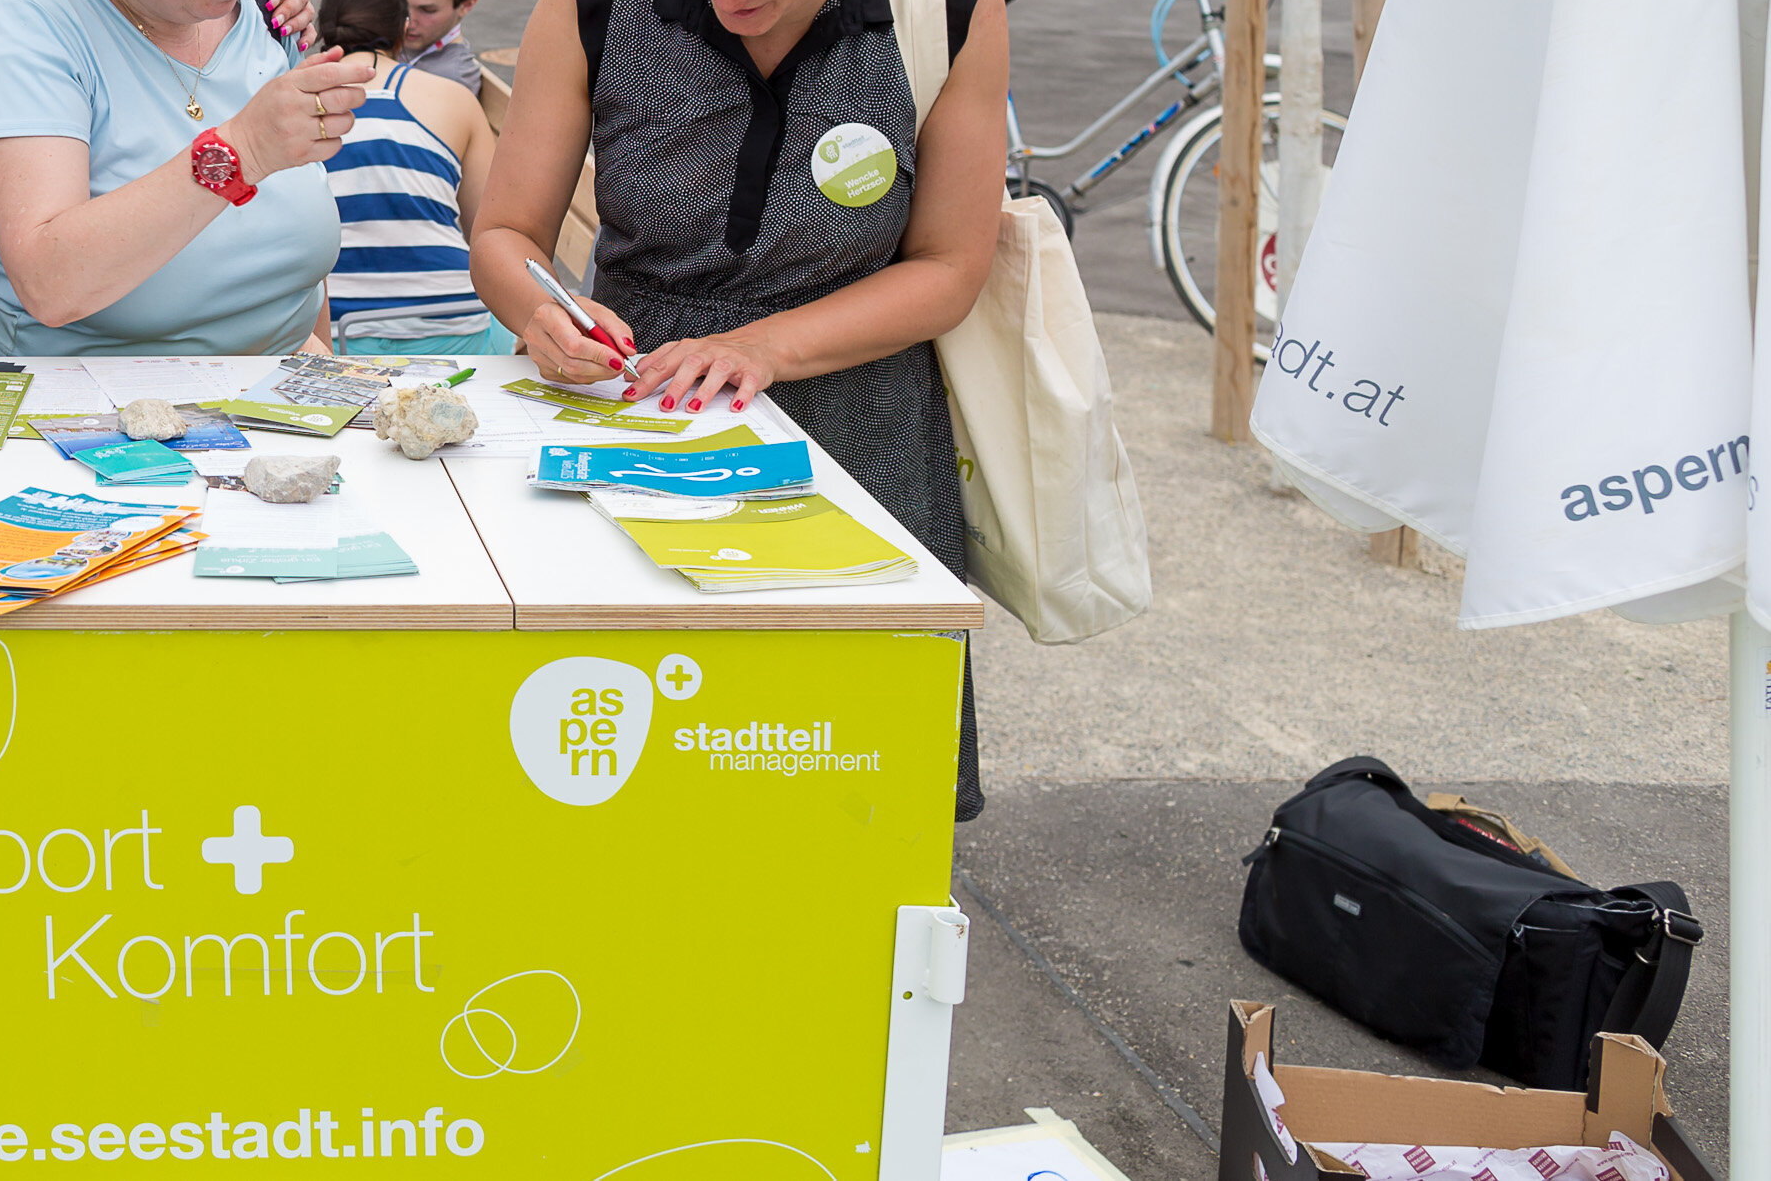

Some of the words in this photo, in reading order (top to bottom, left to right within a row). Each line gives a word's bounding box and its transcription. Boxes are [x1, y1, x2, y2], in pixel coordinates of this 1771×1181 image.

[1560, 435, 1750, 521] aspern
[570, 687, 624, 716] as
[559, 717, 618, 755] pe
[674, 721, 832, 751] stadtteil
[570, 747, 618, 776] rn
[710, 750, 881, 777] management
[45, 909, 435, 1000] Komfort
